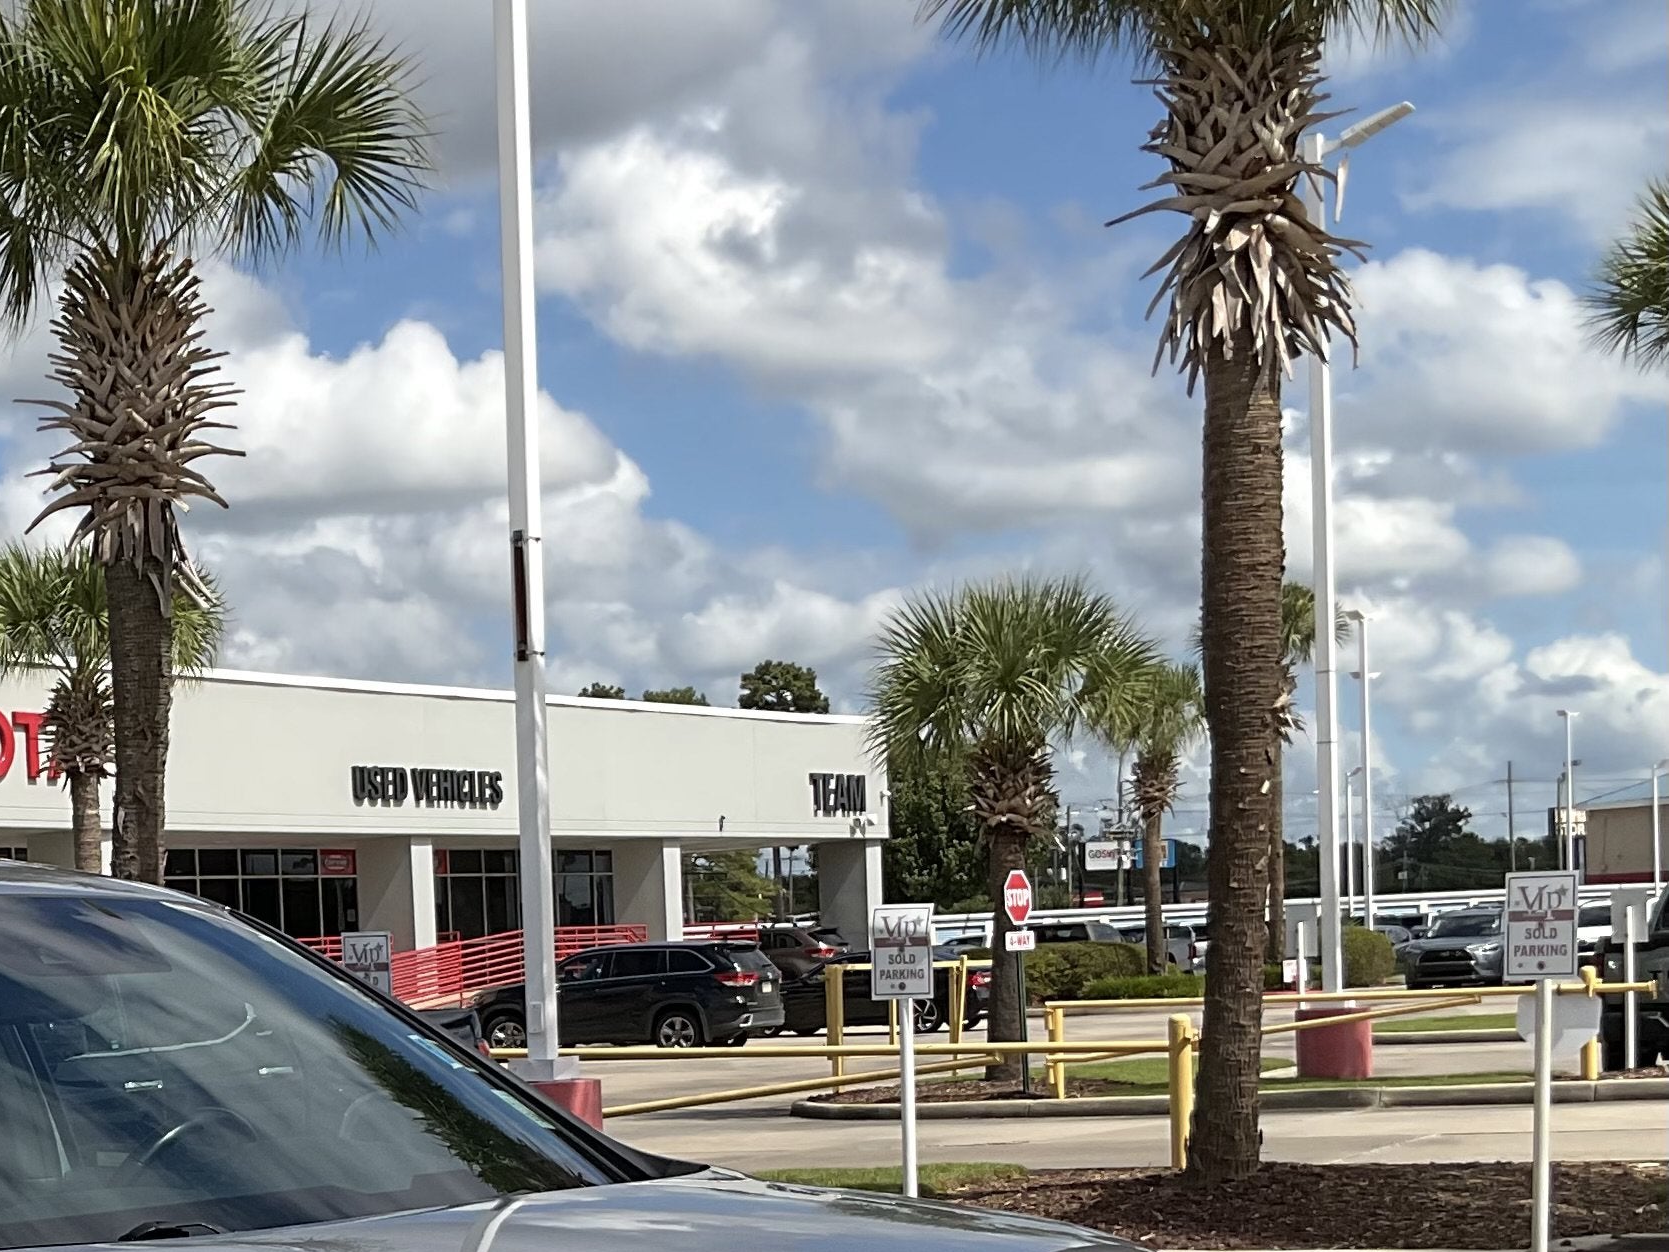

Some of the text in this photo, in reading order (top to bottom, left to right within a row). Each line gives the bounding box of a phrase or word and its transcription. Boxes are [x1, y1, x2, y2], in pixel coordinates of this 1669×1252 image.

[351, 766, 503, 805] USED VEHICLES
[809, 773, 866, 814] TEAM
[1006, 888, 1029, 907] STOP
[1525, 927, 1558, 940] SOLD
[1513, 944, 1568, 958] PARKING
[888, 953, 916, 965] SOLD
[879, 968, 925, 981] PARKING
